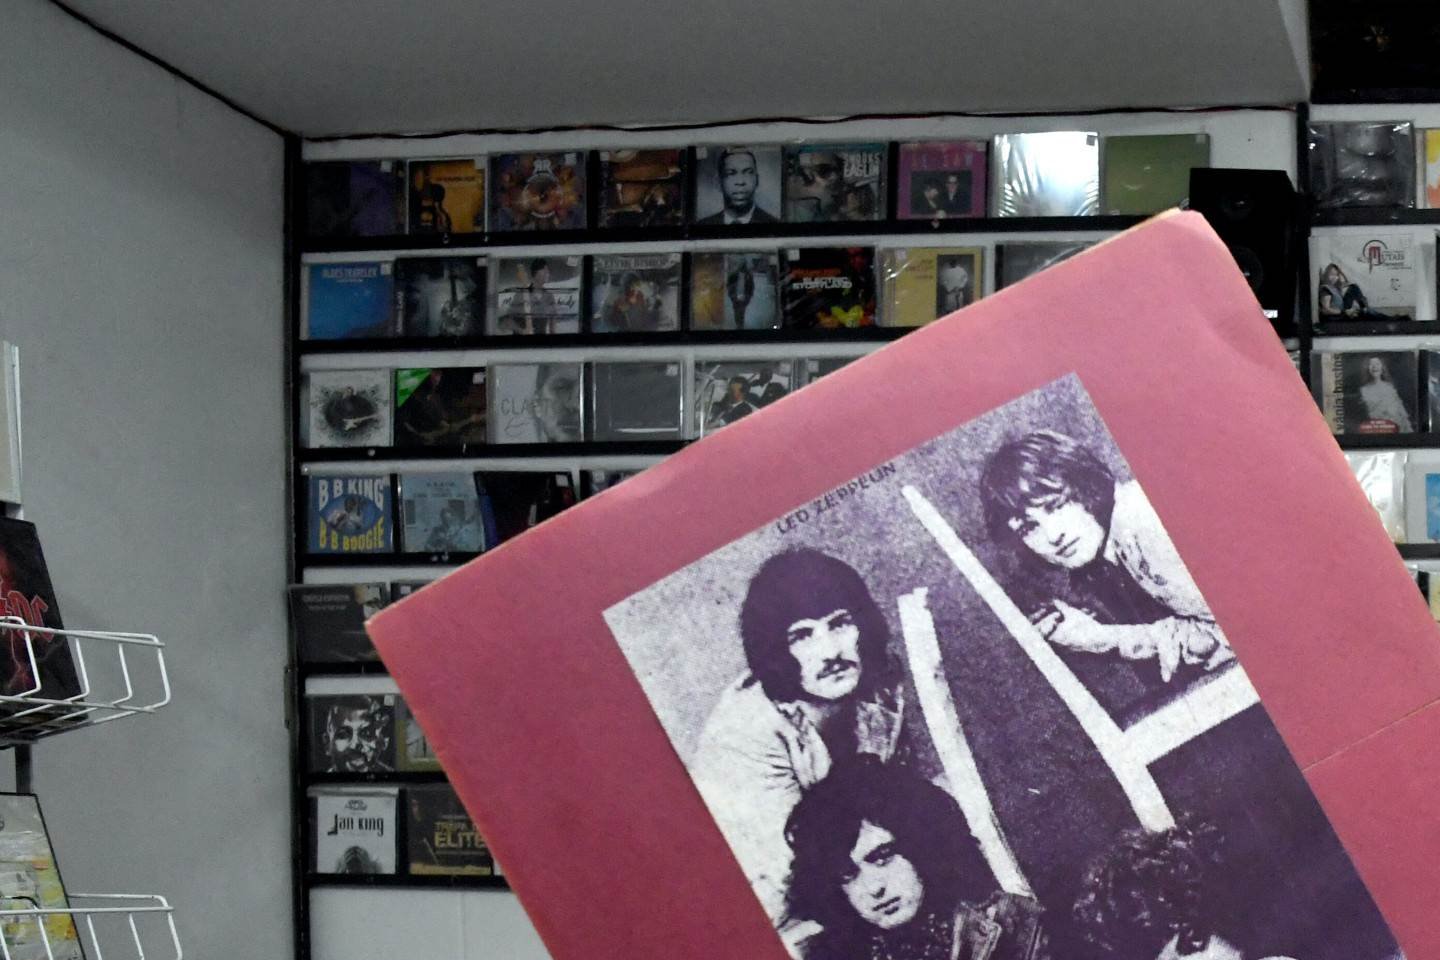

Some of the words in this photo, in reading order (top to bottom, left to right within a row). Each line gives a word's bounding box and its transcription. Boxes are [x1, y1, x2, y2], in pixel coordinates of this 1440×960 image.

[319, 479, 329, 512] B
[347, 478, 384, 512] KING
[776, 510, 809, 535] LED
[815, 462, 897, 515] ZEPPELIN
[343, 515, 384, 551] BOOGIE
